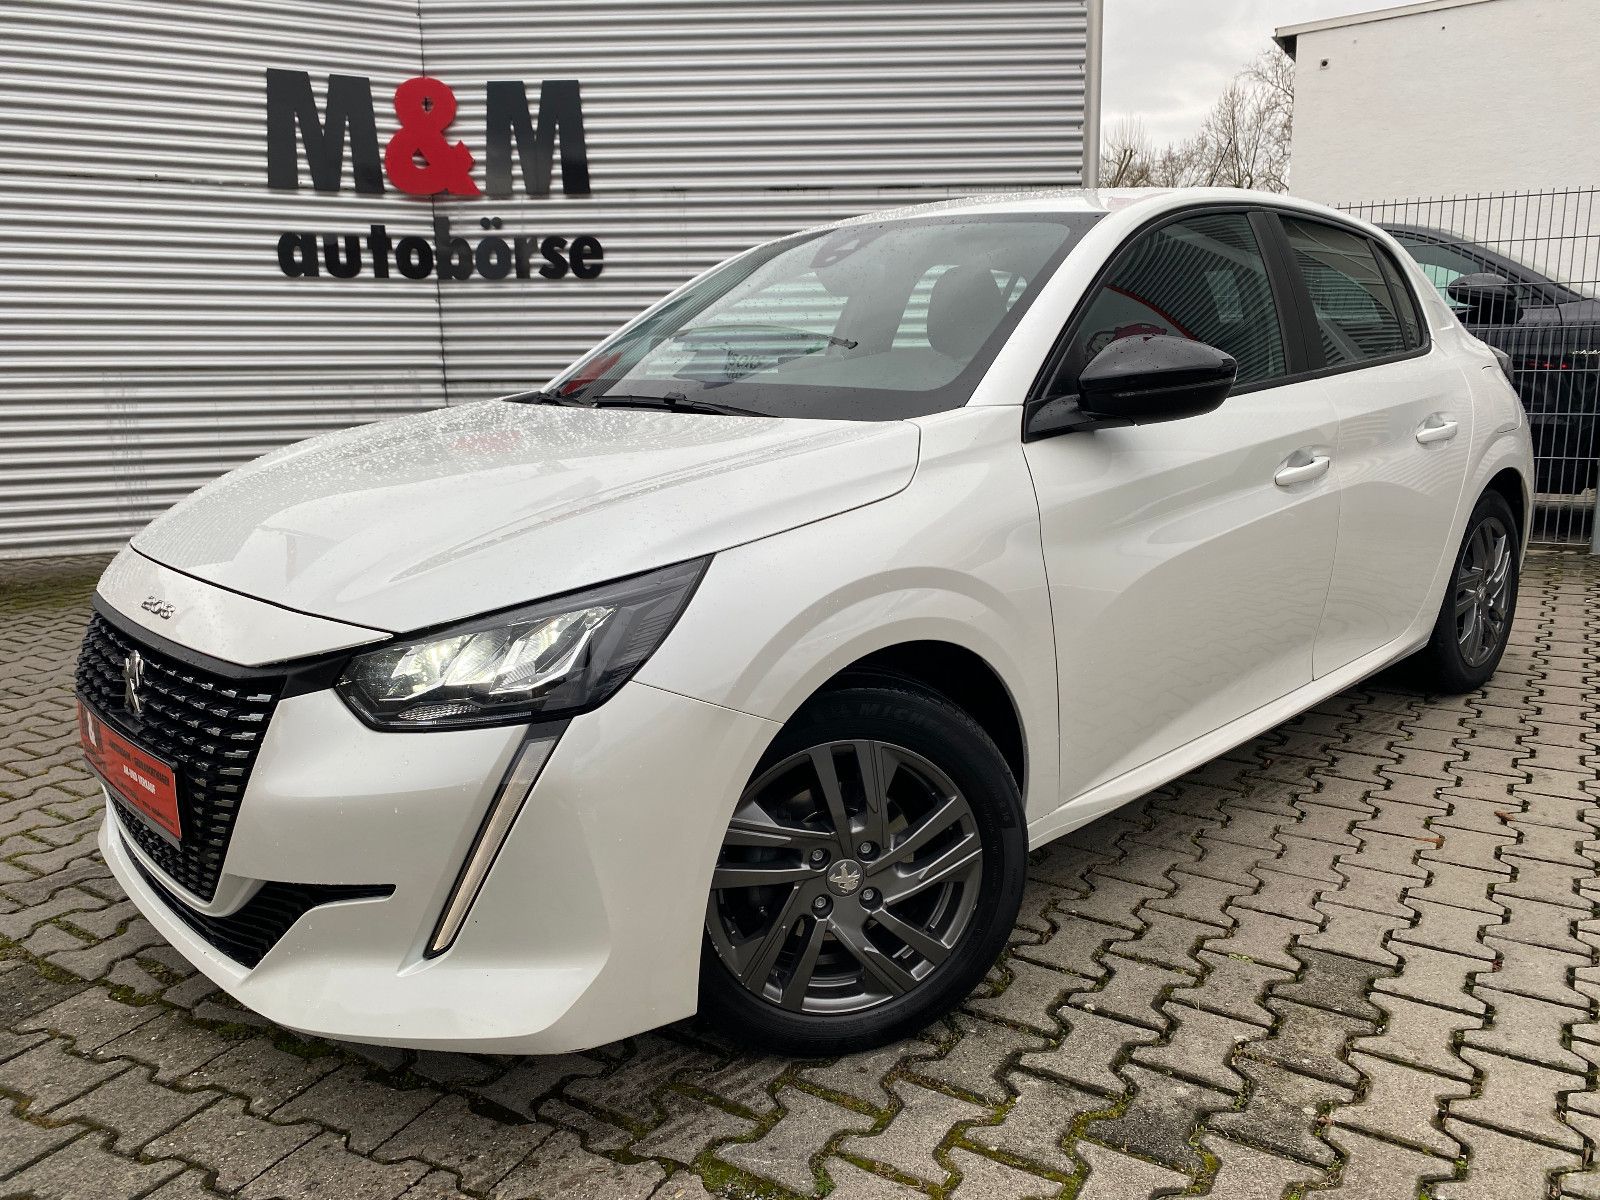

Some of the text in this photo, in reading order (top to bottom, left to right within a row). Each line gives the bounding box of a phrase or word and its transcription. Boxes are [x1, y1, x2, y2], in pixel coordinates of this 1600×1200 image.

[267, 68, 590, 196] M&M
[277, 217, 604, 280] autobörse
[141, 597, 176, 620] 208
